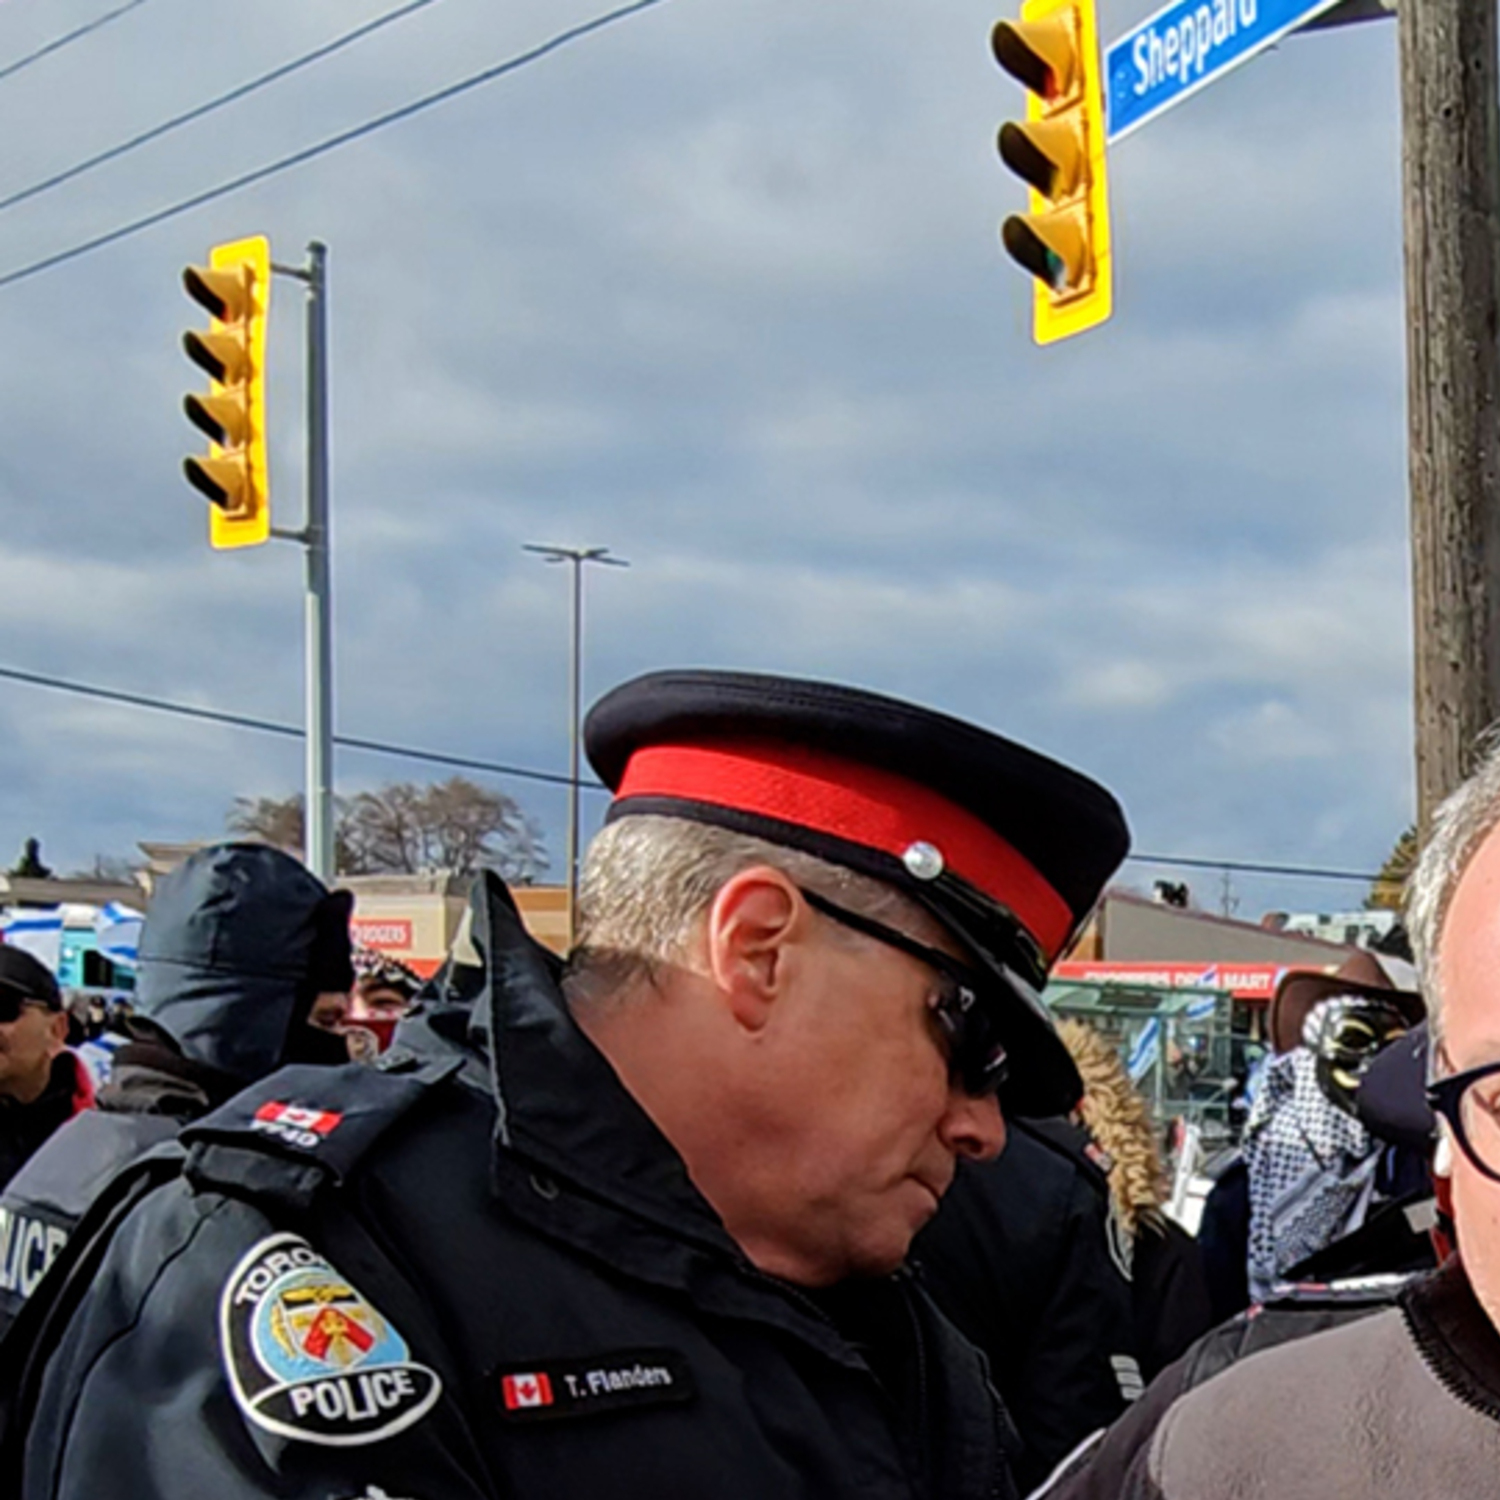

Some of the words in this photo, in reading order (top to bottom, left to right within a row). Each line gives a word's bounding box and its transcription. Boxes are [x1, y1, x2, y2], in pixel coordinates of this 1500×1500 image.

[234, 1247, 328, 1306] TORO
[290, 1369, 415, 1421] POLICE
[563, 1373, 587, 1398] T.
[586, 1364, 673, 1396] Flanders
